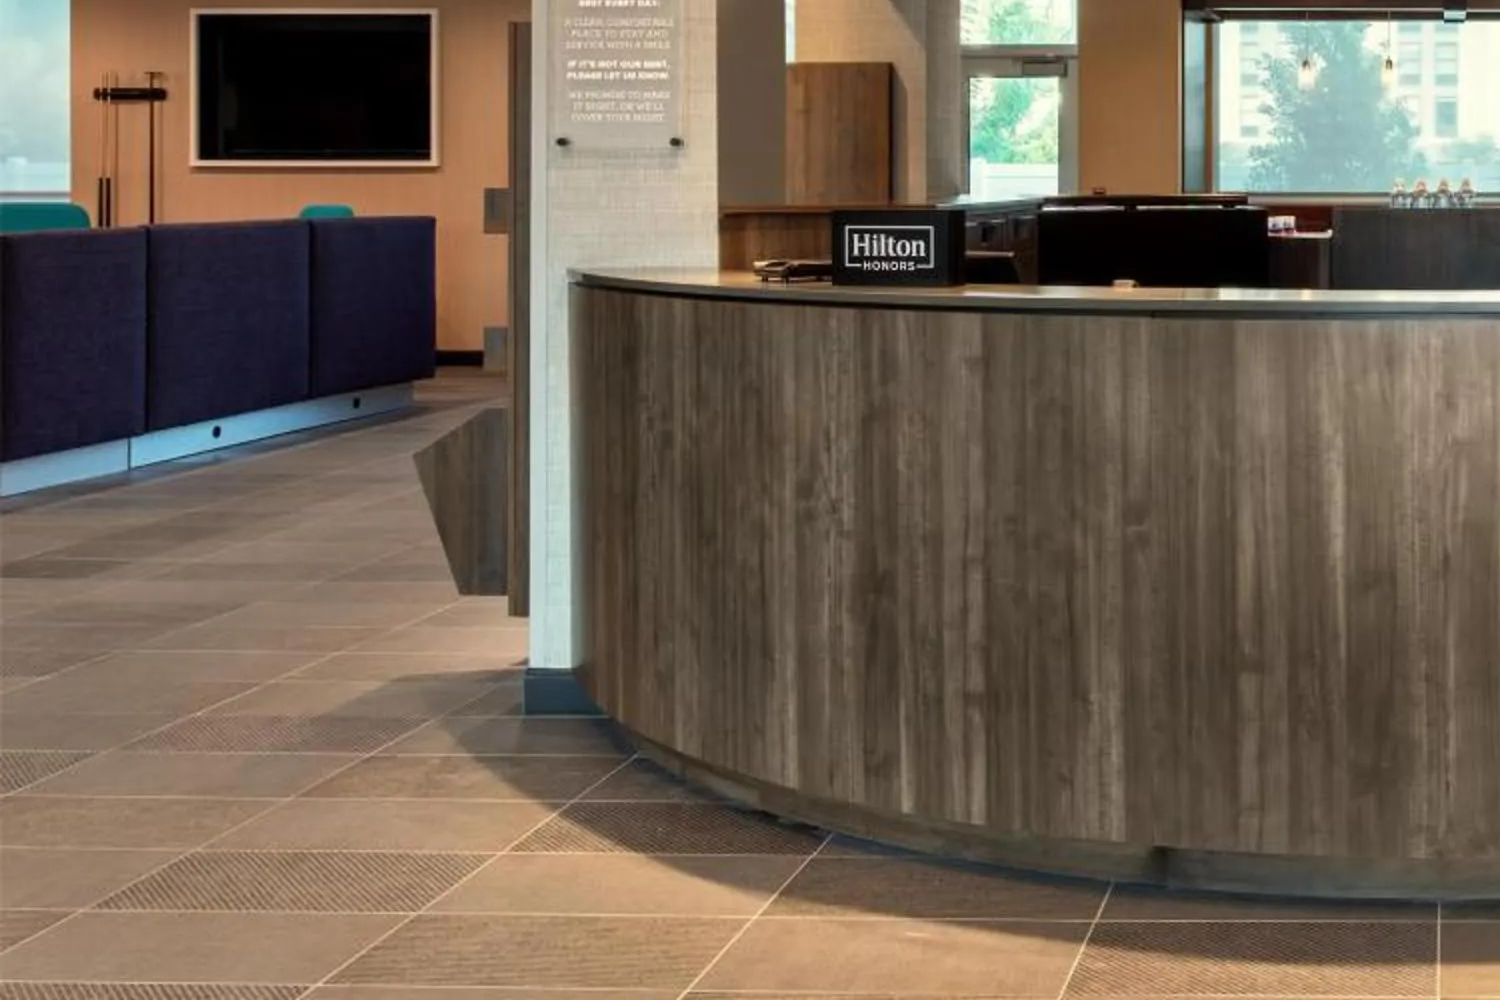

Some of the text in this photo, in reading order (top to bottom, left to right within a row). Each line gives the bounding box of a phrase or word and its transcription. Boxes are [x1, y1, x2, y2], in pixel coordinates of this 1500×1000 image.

[598, 60, 618, 69] NOT
[852, 233, 926, 257] Hilton
[863, 261, 916, 271] HONORS
